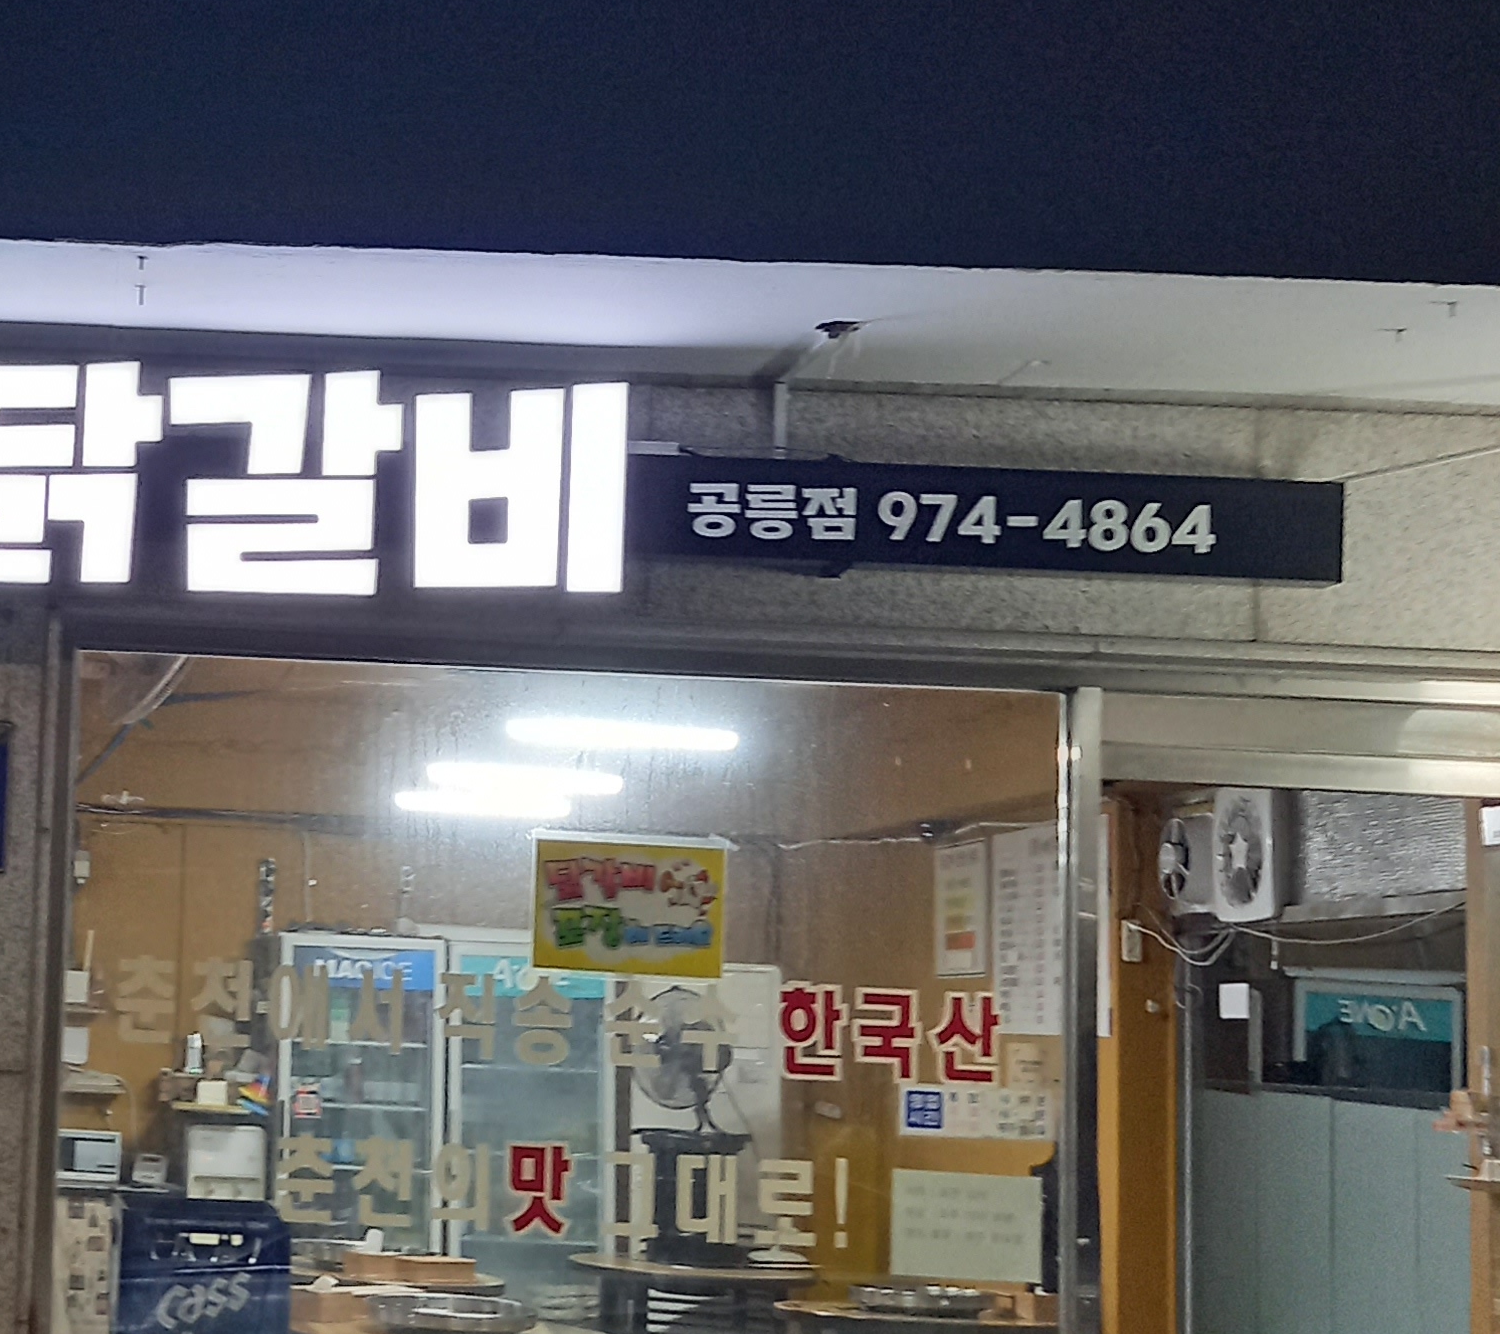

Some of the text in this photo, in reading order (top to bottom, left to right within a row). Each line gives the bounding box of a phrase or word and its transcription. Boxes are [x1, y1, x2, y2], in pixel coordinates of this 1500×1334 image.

[686, 481, 1218, 555] 공릉점 974-4864
[114, 954, 407, 1056] 춘천에서
[436, 971, 573, 1066] 직송
[779, 980, 1002, 1085] 한국산
[275, 1134, 490, 1242] 춘천의
[505, 1139, 574, 1237] 맛
[600, 1149, 850, 1250] 그대로!
